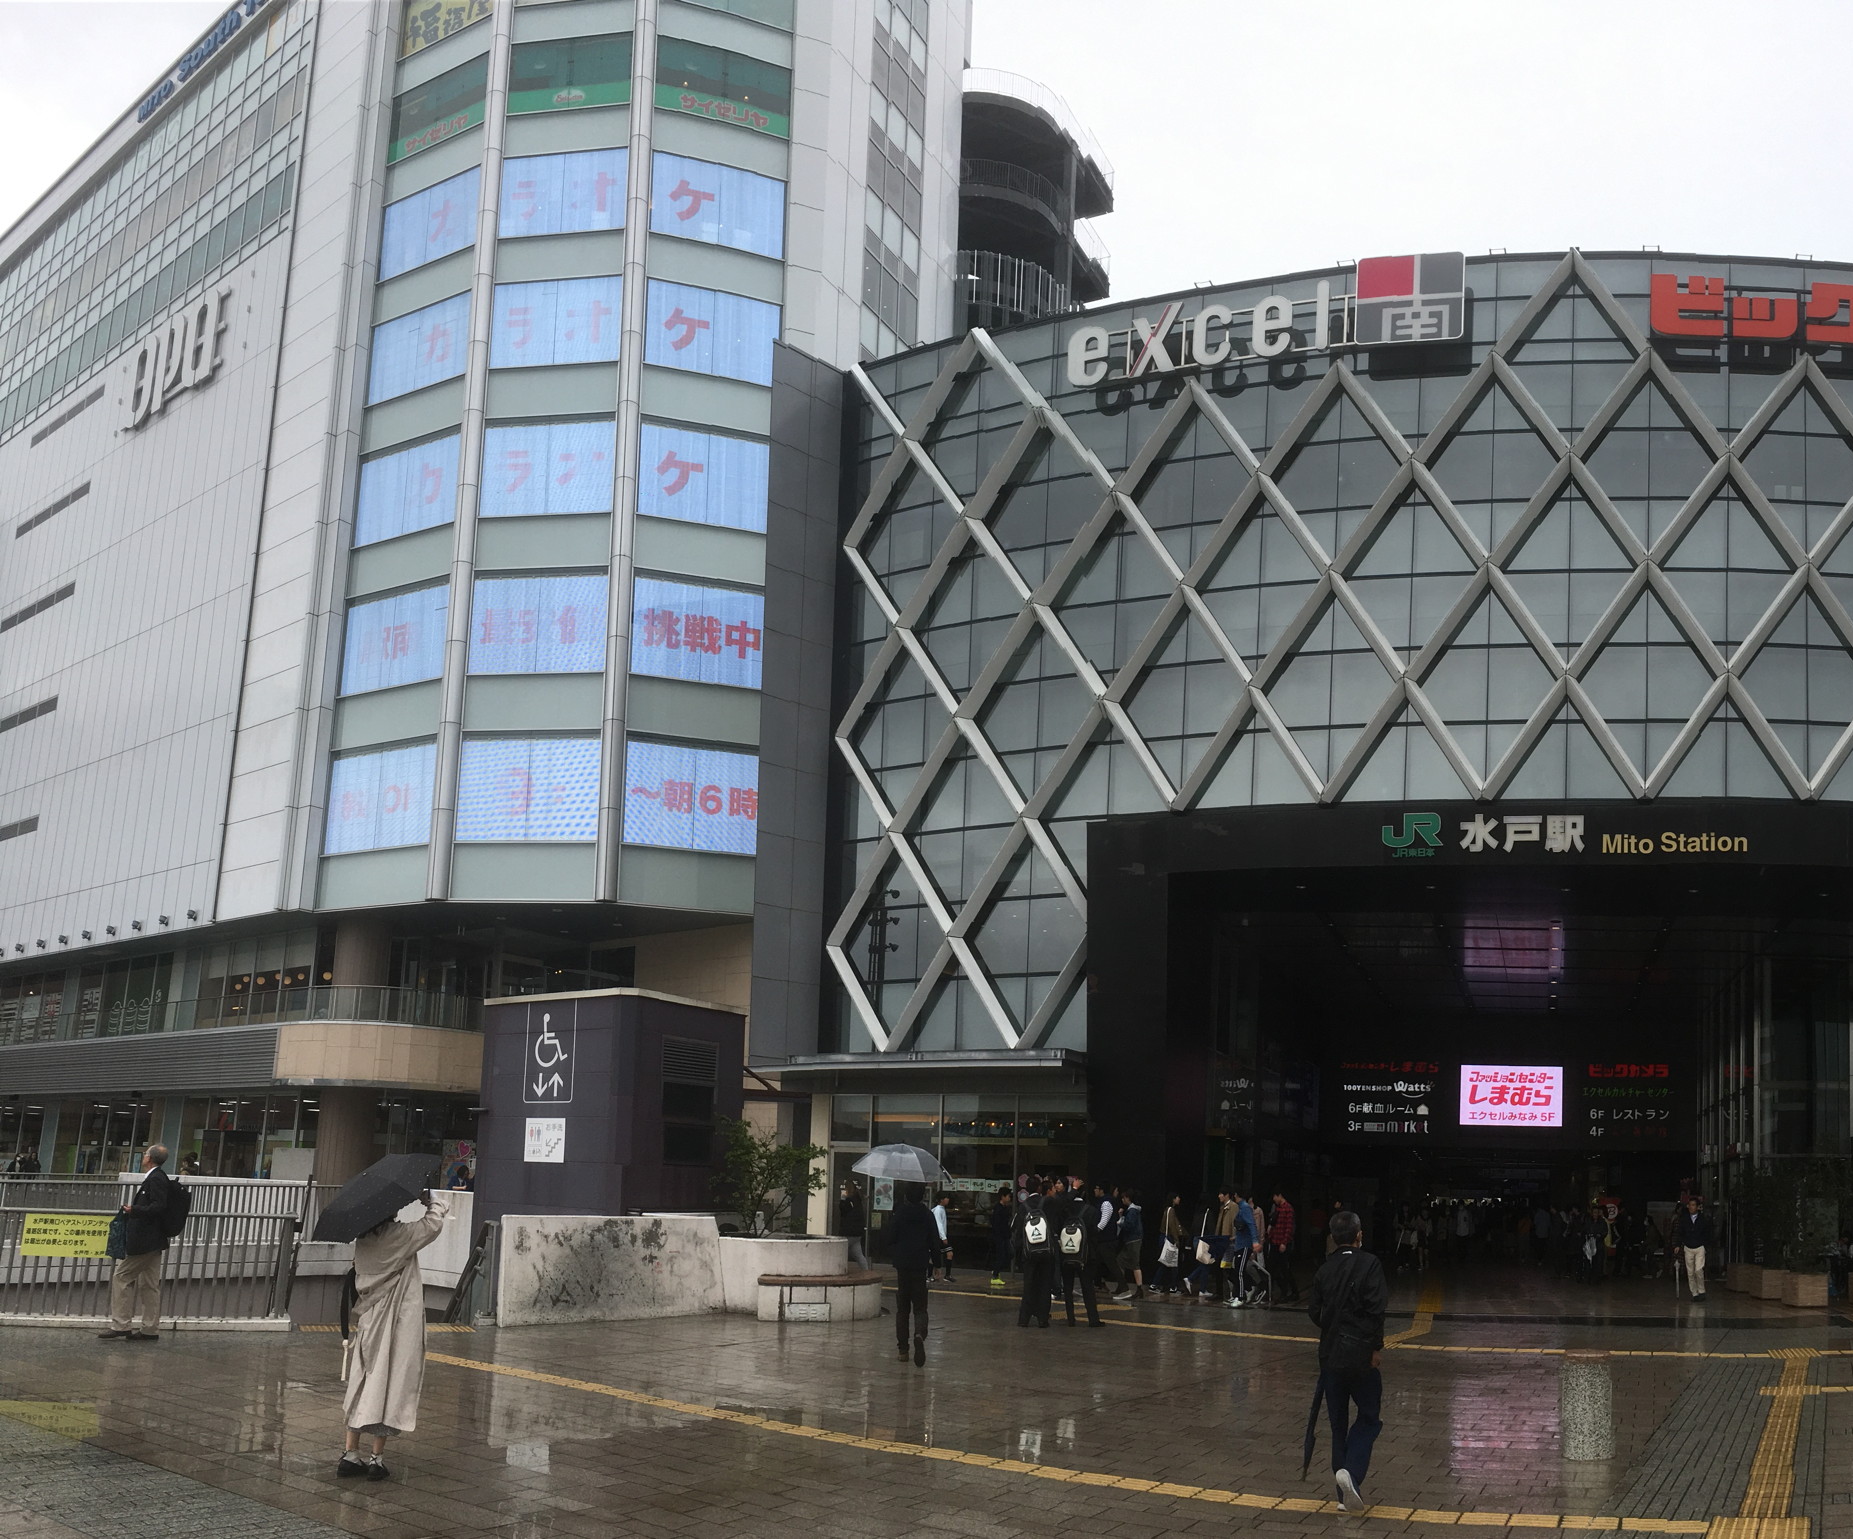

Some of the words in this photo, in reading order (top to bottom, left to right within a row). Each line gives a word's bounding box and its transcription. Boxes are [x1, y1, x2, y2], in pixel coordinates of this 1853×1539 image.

[681, 94, 768, 128] サイゼリヤ
[405, 113, 469, 153] サイゼリヤ
[1067, 280, 1331, 387] excel
[642, 607, 762, 659] 挑戦中
[1381, 812, 1444, 847] JR
[1459, 813, 1585, 854] 水戸駅
[1602, 832, 1654, 854] Mito
[1660, 831, 1748, 853] Station
[1391, 847, 1435, 858] JR東日本
[1469, 1071, 1554, 1083] ファッションセンター
[1588, 1064, 1669, 1077] ビックカメラ
[1393, 1080, 1431, 1092] Watts
[1468, 1084, 1554, 1106] しまむら
[1468, 1111, 1538, 1121] エクセルみなみ
[1540, 1112, 1555, 1121] 5F
[1589, 1108, 1605, 1119] 6F
[1612, 1108, 1670, 1120] レストラン
[1347, 1120, 1362, 1131] 3F
[1589, 1126, 1605, 1136] 4F
